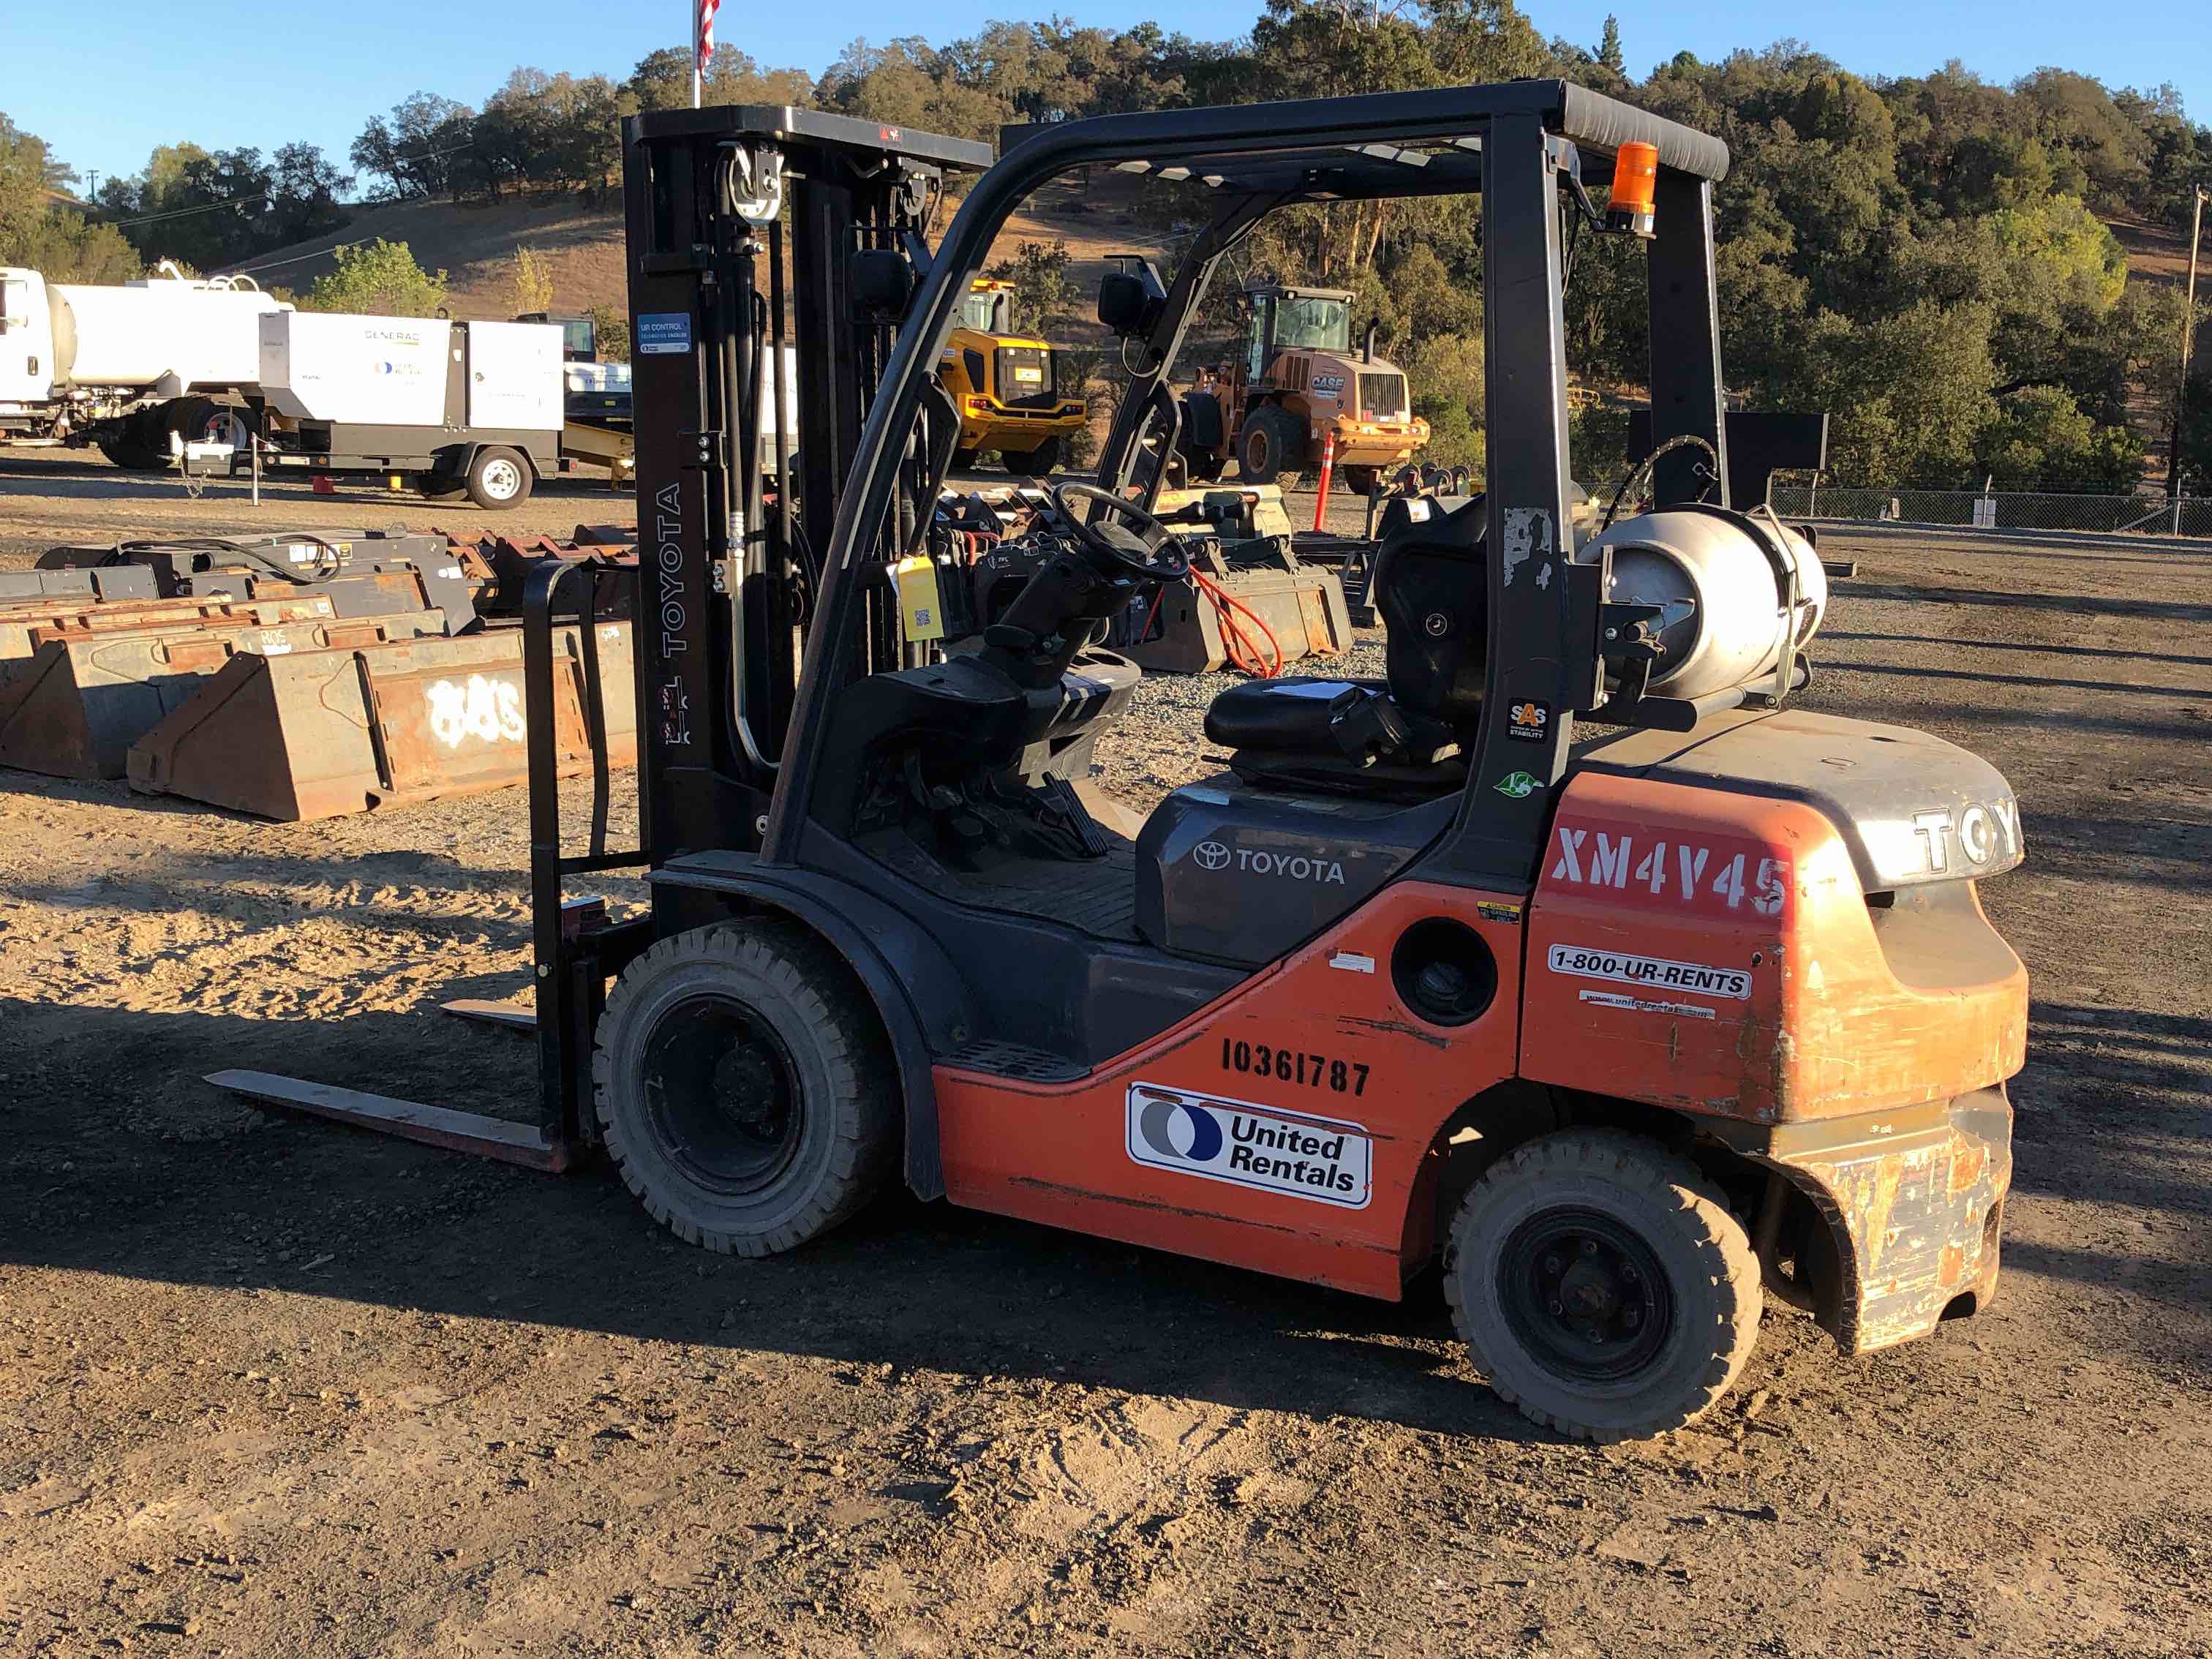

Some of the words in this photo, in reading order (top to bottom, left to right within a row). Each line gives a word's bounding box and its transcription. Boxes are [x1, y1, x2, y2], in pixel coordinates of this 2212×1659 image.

[364, 329, 421, 341] GENERAC
[651, 323, 682, 331] CONTROL
[1311, 375, 1346, 388] CASE
[656, 483, 687, 658] TOYOTA
[1510, 729, 1543, 738] STABILITY
[1511, 703, 1546, 726] SAS
[1236, 849, 1345, 885] TOYOTA
[1551, 827, 1787, 914] XM4V45
[1556, 951, 1745, 993] 1-800-UR-RENTS
[1222, 1038, 1370, 1096] 10361787
[1231, 1116, 1344, 1161] United
[1229, 1144, 1355, 1192] Rentals
